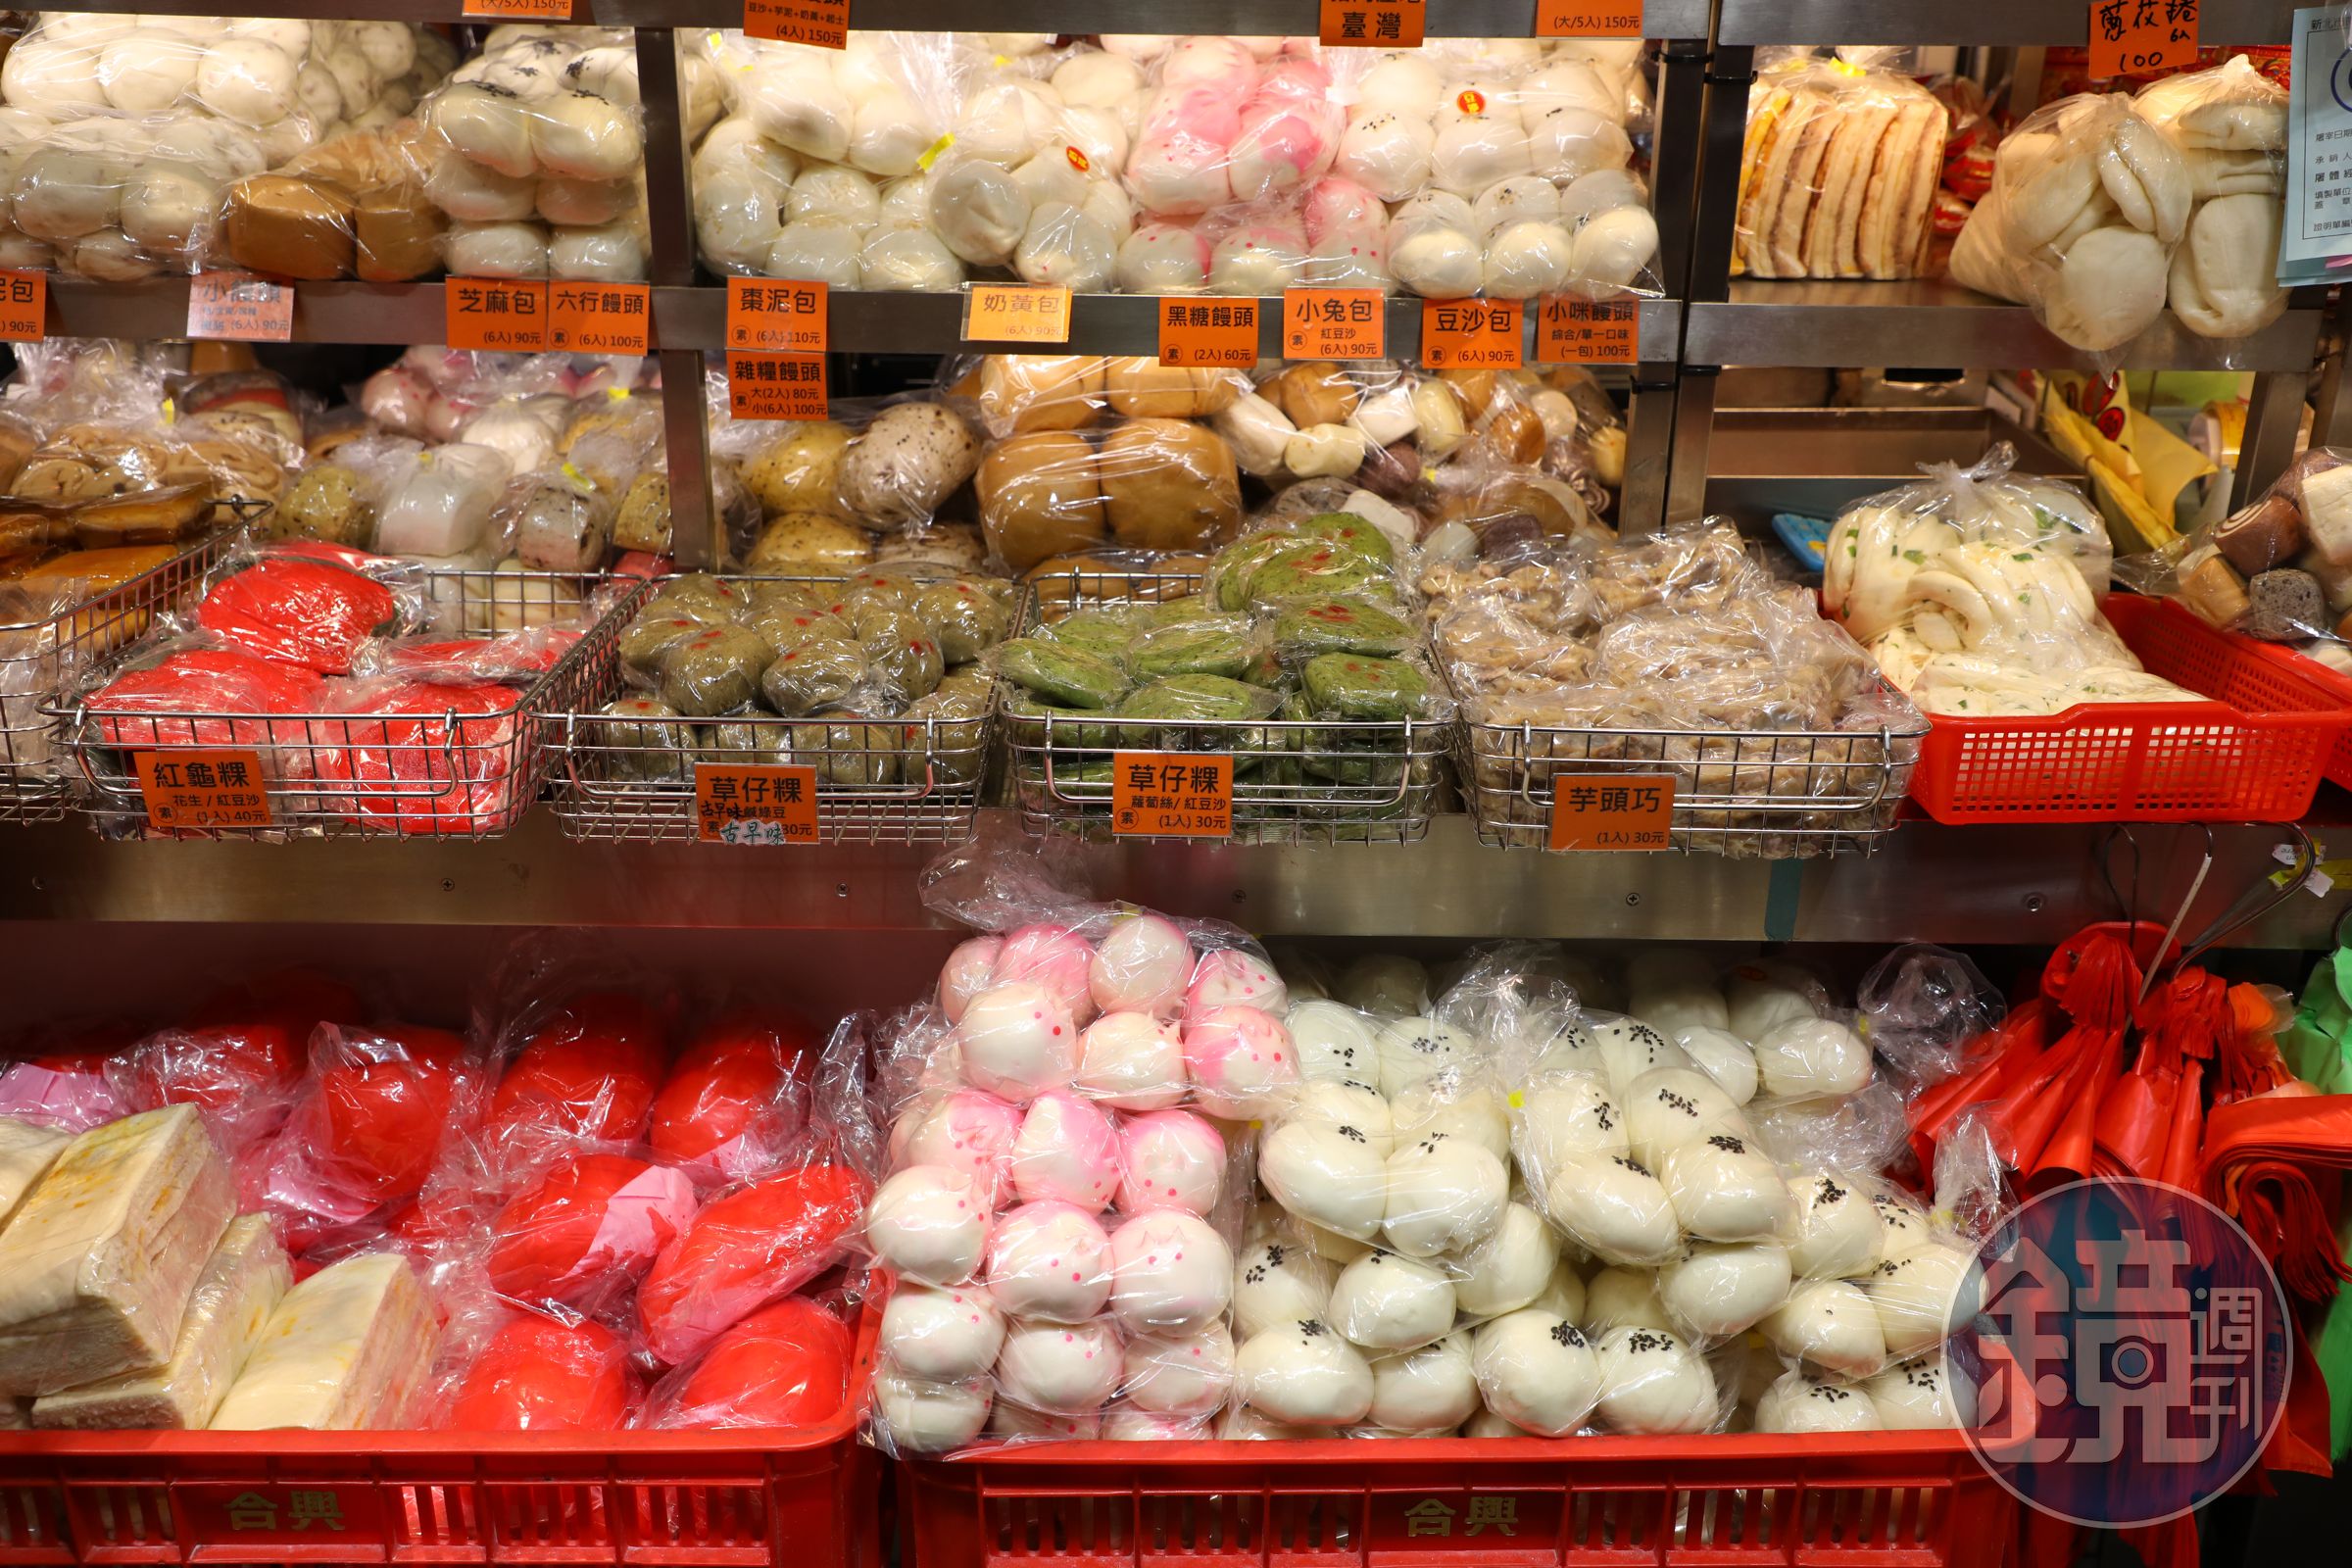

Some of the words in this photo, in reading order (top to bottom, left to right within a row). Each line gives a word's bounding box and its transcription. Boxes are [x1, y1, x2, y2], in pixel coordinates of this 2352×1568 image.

[1342, 12, 1401, 39] 臺灣
[1553, 16, 1601, 29] (大/5入)
[1604, 16, 1640, 28] 150元
[776, 24, 805, 40] (4入)
[808, 29, 843, 45] 150元
[2120, 52, 2163, 73] 100
[0, 278, 33, 303] 包
[458, 288, 536, 315] 芝麻包
[557, 290, 645, 316] 六行饅頭
[740, 288, 816, 315] 棗泥包
[983, 294, 1059, 314] 奶黃包
[1296, 298, 1372, 322] 小兔包
[1546, 302, 1634, 322] 小咪饅頭
[9, 320, 37, 333] 90元
[1167, 306, 1254, 328] 黑糖饅頭
[1435, 308, 1511, 333] 豆沙包
[483, 331, 512, 345] (6入)
[514, 331, 542, 344] 90元
[579, 334, 607, 348] (6入)
[610, 335, 644, 349] 100元
[787, 331, 821, 344] 110元
[1320, 328, 1356, 340] 紅豆沙
[1194, 349, 1222, 362] (2入)
[1224, 349, 1251, 361] 60元
[1320, 344, 1348, 357] (6入)
[1350, 343, 1378, 355] 90元
[1458, 350, 1486, 363] (6入)
[1488, 350, 1515, 363] 90元
[1561, 345, 1593, 359] (一包)
[1596, 345, 1631, 357] 100元
[735, 361, 821, 382] 雜糧饅頭
[751, 387, 791, 401] 大(2入)
[793, 388, 819, 400] 80元
[752, 403, 791, 416] 小(6入)
[794, 404, 826, 416] 100元
[153, 761, 250, 788] 紅龜粿
[1128, 764, 1220, 794] 草仔粿
[709, 776, 804, 804] 草仔粿
[1569, 787, 1663, 813] 芋頭巧
[234, 810, 268, 822] 40元
[1158, 815, 1192, 829] (1入)
[1196, 815, 1227, 829] 30元
[720, 819, 785, 846] 古早味
[1596, 831, 1631, 845] (1入)
[1634, 831, 1665, 844] 30元
[224, 1490, 346, 1531] 合興
[1403, 1496, 1519, 1538] 合興
